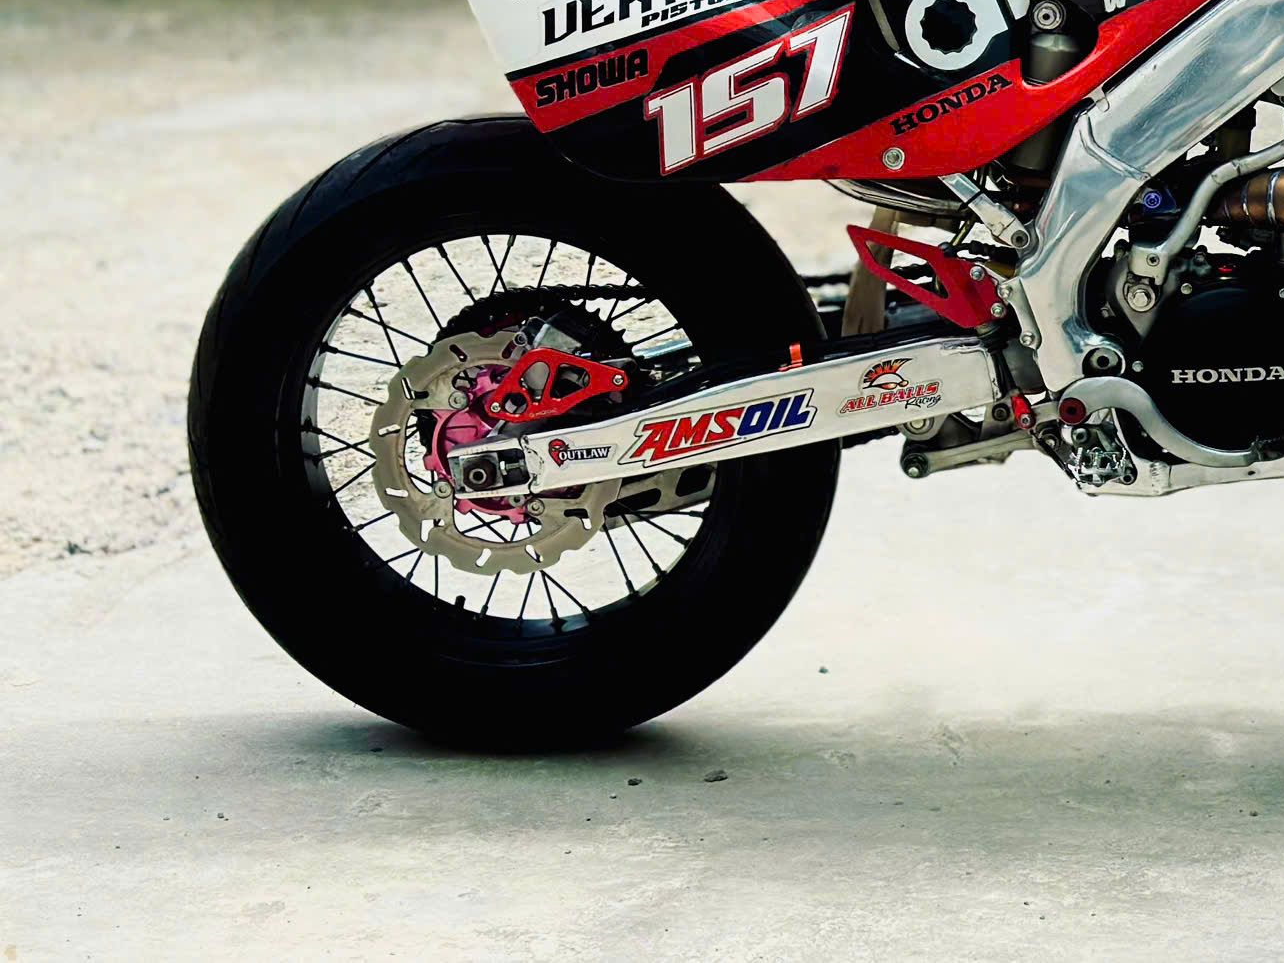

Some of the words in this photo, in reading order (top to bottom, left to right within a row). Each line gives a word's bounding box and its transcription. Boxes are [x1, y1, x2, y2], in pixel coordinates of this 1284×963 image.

[536, 48, 649, 108] SHOWA
[645, 3, 854, 175] 157
[889, 72, 1012, 135] HONDA
[840, 394, 877, 413] ALL
[878, 381, 940, 406] BALLS
[904, 394, 942, 410] Racing
[558, 445, 612, 461] OUTLAW
[630, 393, 810, 462] AMSOIL
